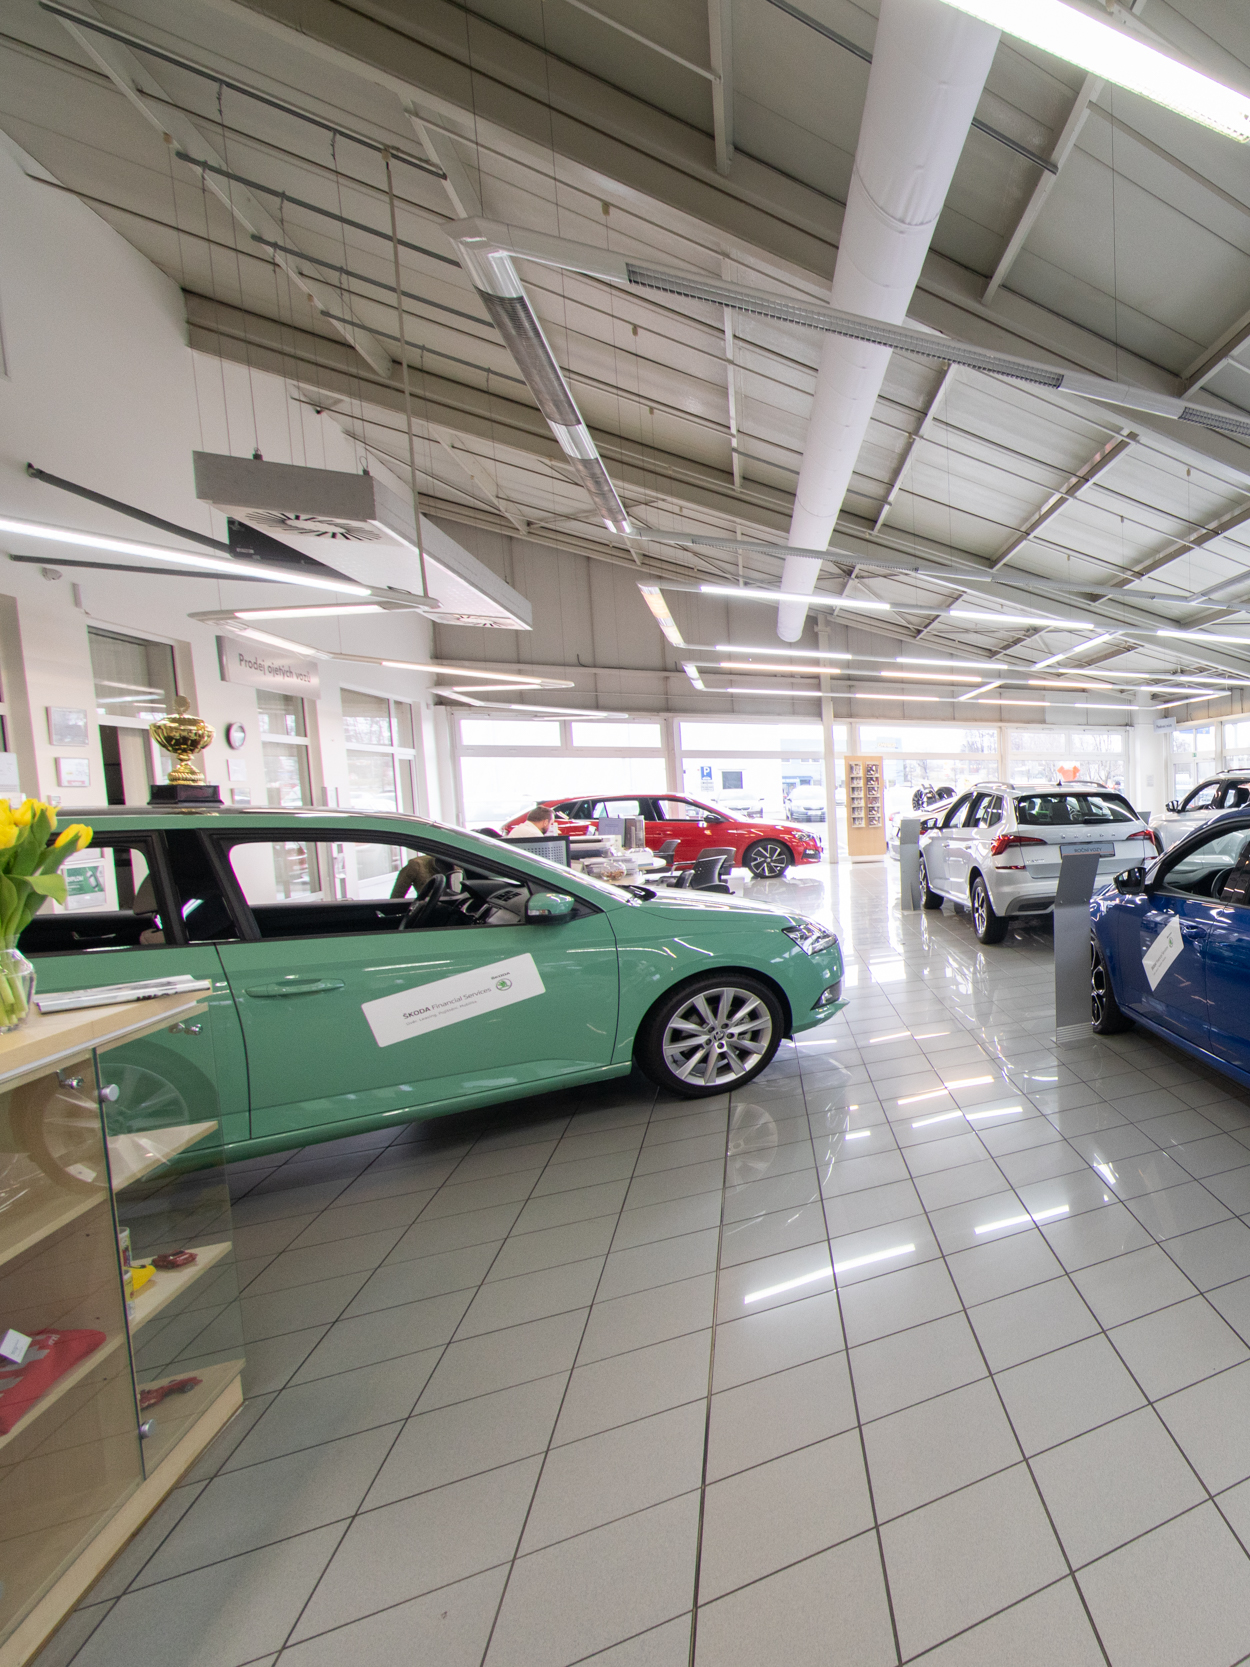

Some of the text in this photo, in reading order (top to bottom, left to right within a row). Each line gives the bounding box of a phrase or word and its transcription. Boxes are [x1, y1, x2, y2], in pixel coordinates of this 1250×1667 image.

[238, 653, 266, 675] Prodej
[267, 662, 294, 680] ojetých
[703, 766, 710, 775] P
[403, 988, 492, 1020] ŠKODA Financial Services
